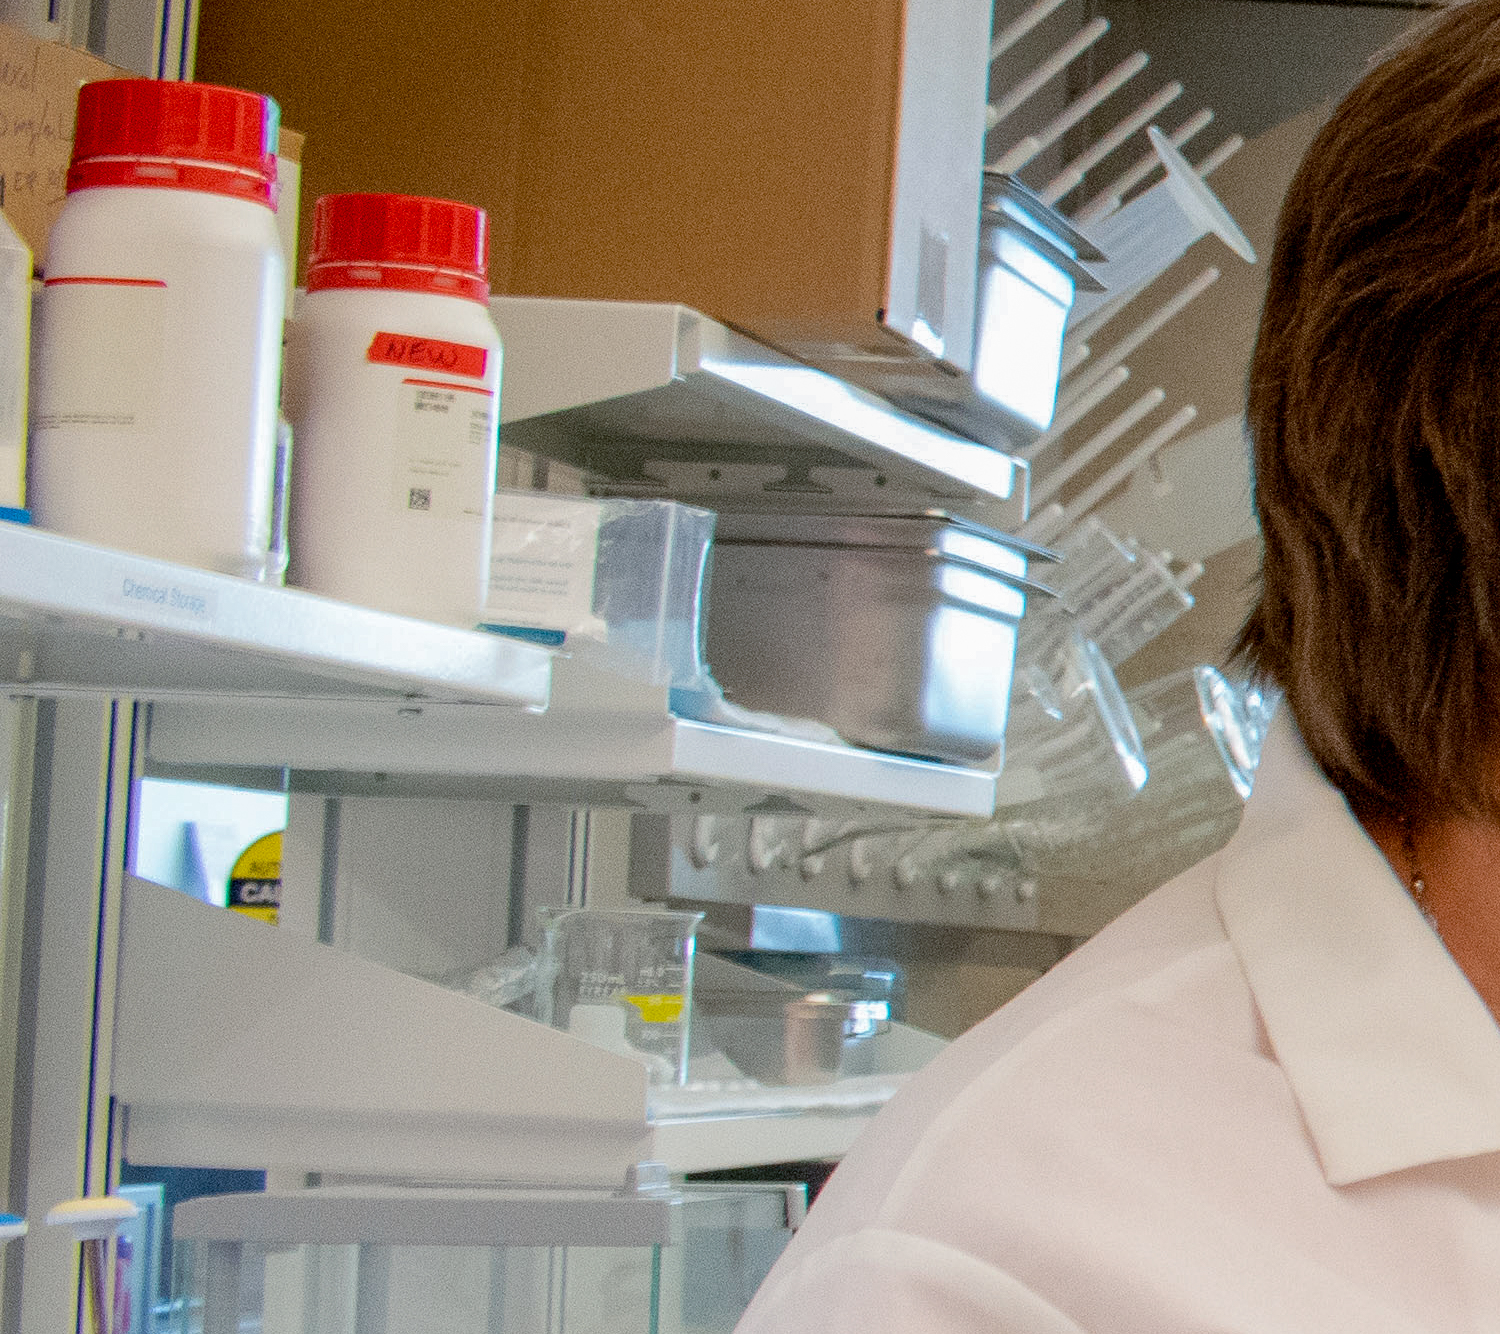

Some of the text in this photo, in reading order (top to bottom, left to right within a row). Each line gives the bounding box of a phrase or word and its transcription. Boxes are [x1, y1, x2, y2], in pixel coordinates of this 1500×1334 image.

[386, 339, 459, 368] NEW
[123, 578, 208, 615] Chemical Storage
